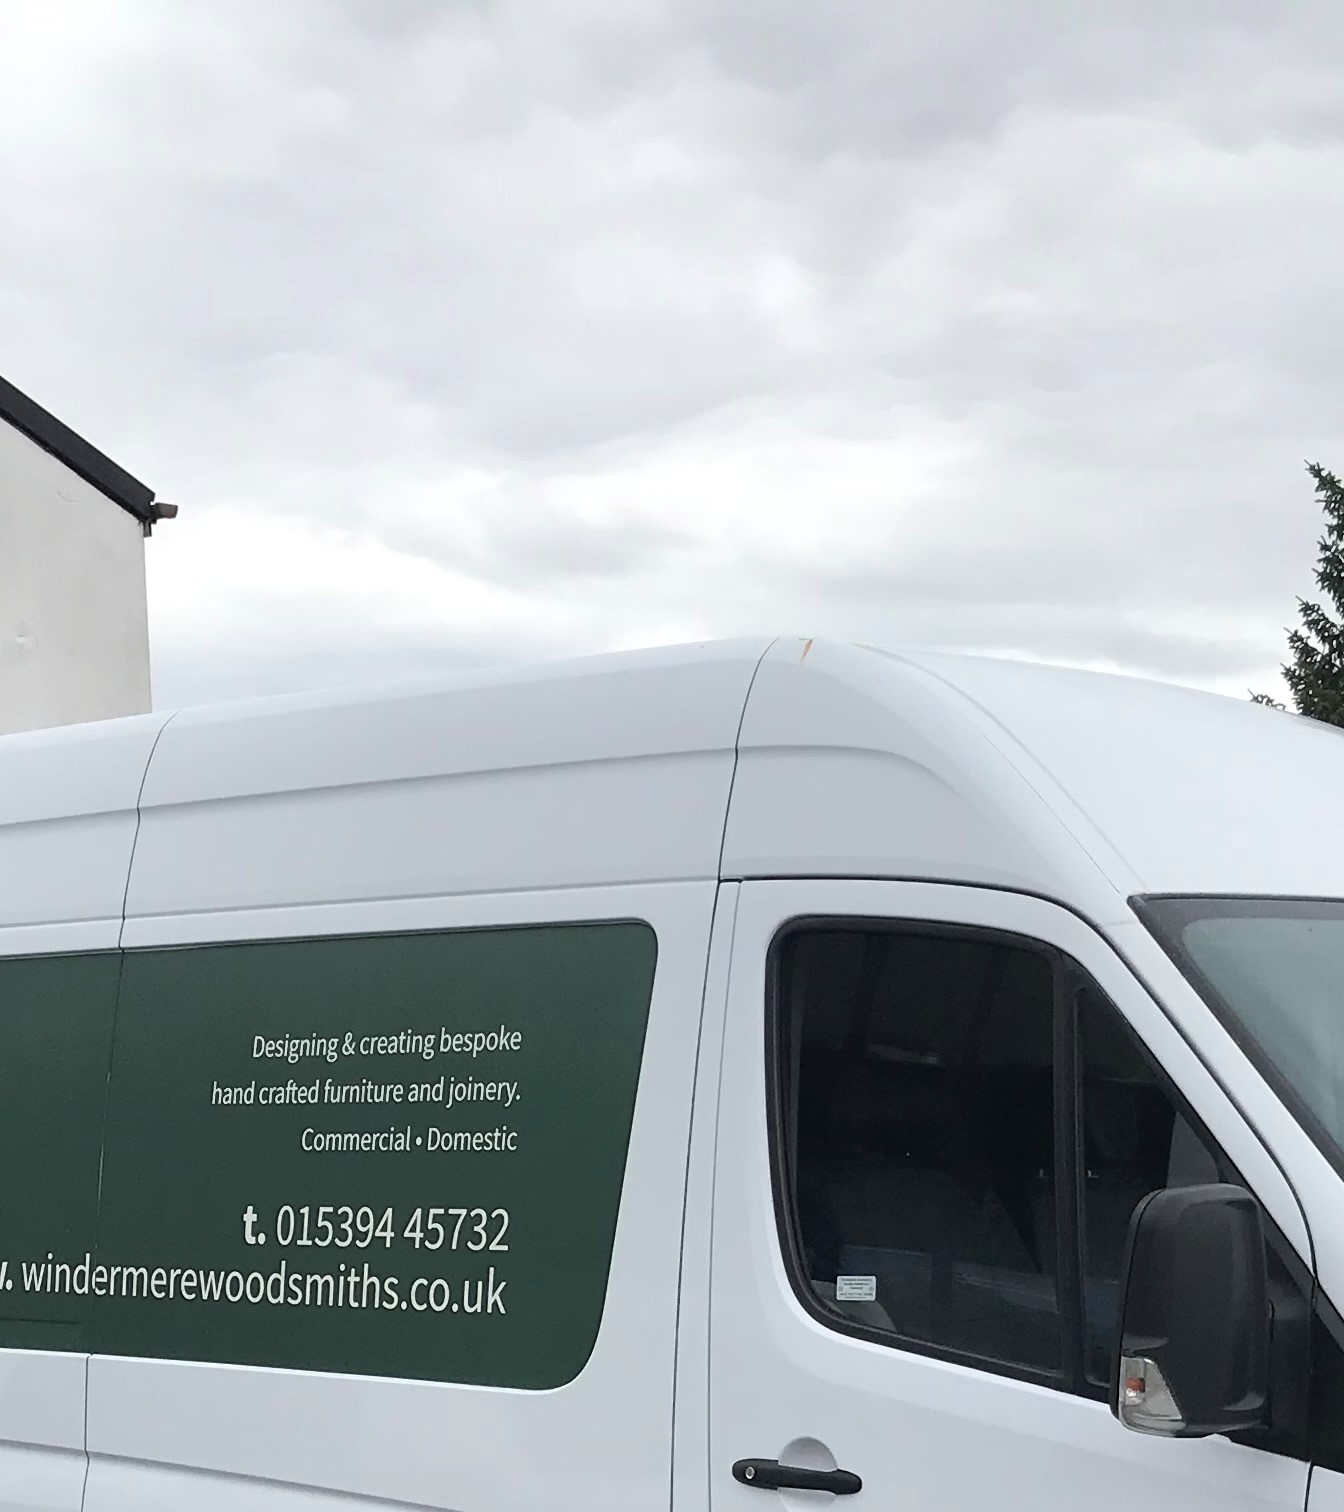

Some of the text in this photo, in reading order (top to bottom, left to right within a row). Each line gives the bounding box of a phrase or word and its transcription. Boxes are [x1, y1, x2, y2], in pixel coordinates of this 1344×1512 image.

[252, 1024, 522, 1063] Designing & creating bespoke
[211, 1075, 521, 1109] hand crafted furniture and joinery.
[301, 1125, 518, 1152] Commercial Domestic
[242, 1205, 510, 1252] t. 015394 45732
[21, 1252, 508, 1316] windermerewoodsmiths.co.uk
